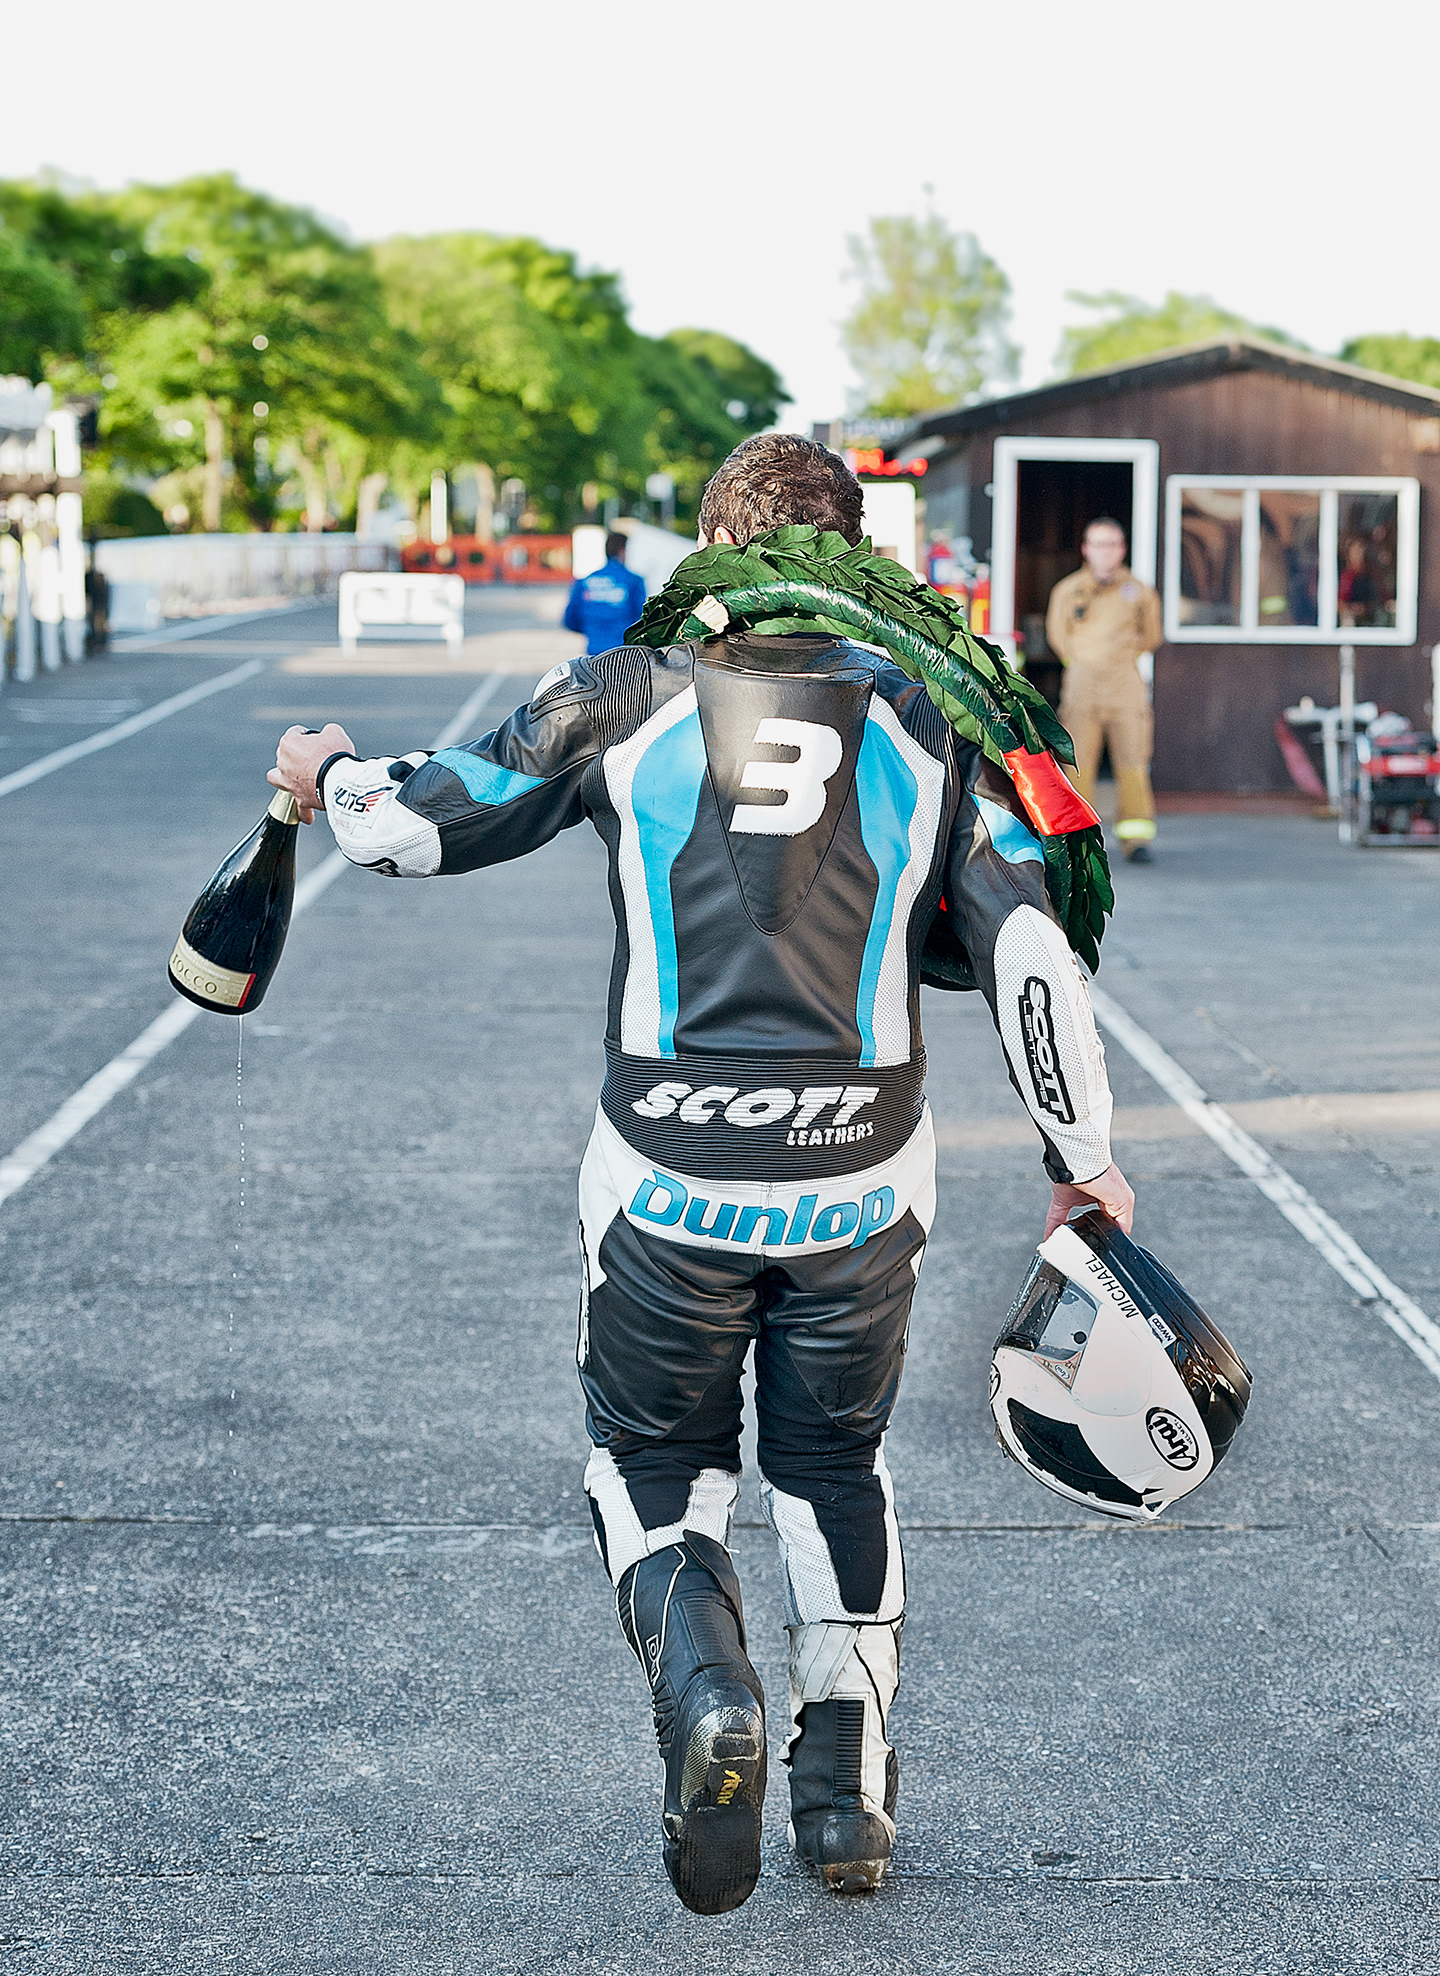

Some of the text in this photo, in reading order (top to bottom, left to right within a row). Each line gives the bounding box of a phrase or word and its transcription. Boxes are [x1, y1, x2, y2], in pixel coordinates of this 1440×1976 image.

[728, 717, 843, 837] 3
[1023, 1000, 1049, 1104] LEATHERS
[1029, 980, 1071, 1122] SCOTT
[630, 1081, 880, 1129] SCOTT
[786, 1121, 875, 1147] LEATHERS
[628, 1169, 896, 1250] Dunlop
[1085, 1253, 1140, 1319] MICHAEL
[1148, 1415, 1198, 1461] Arai
